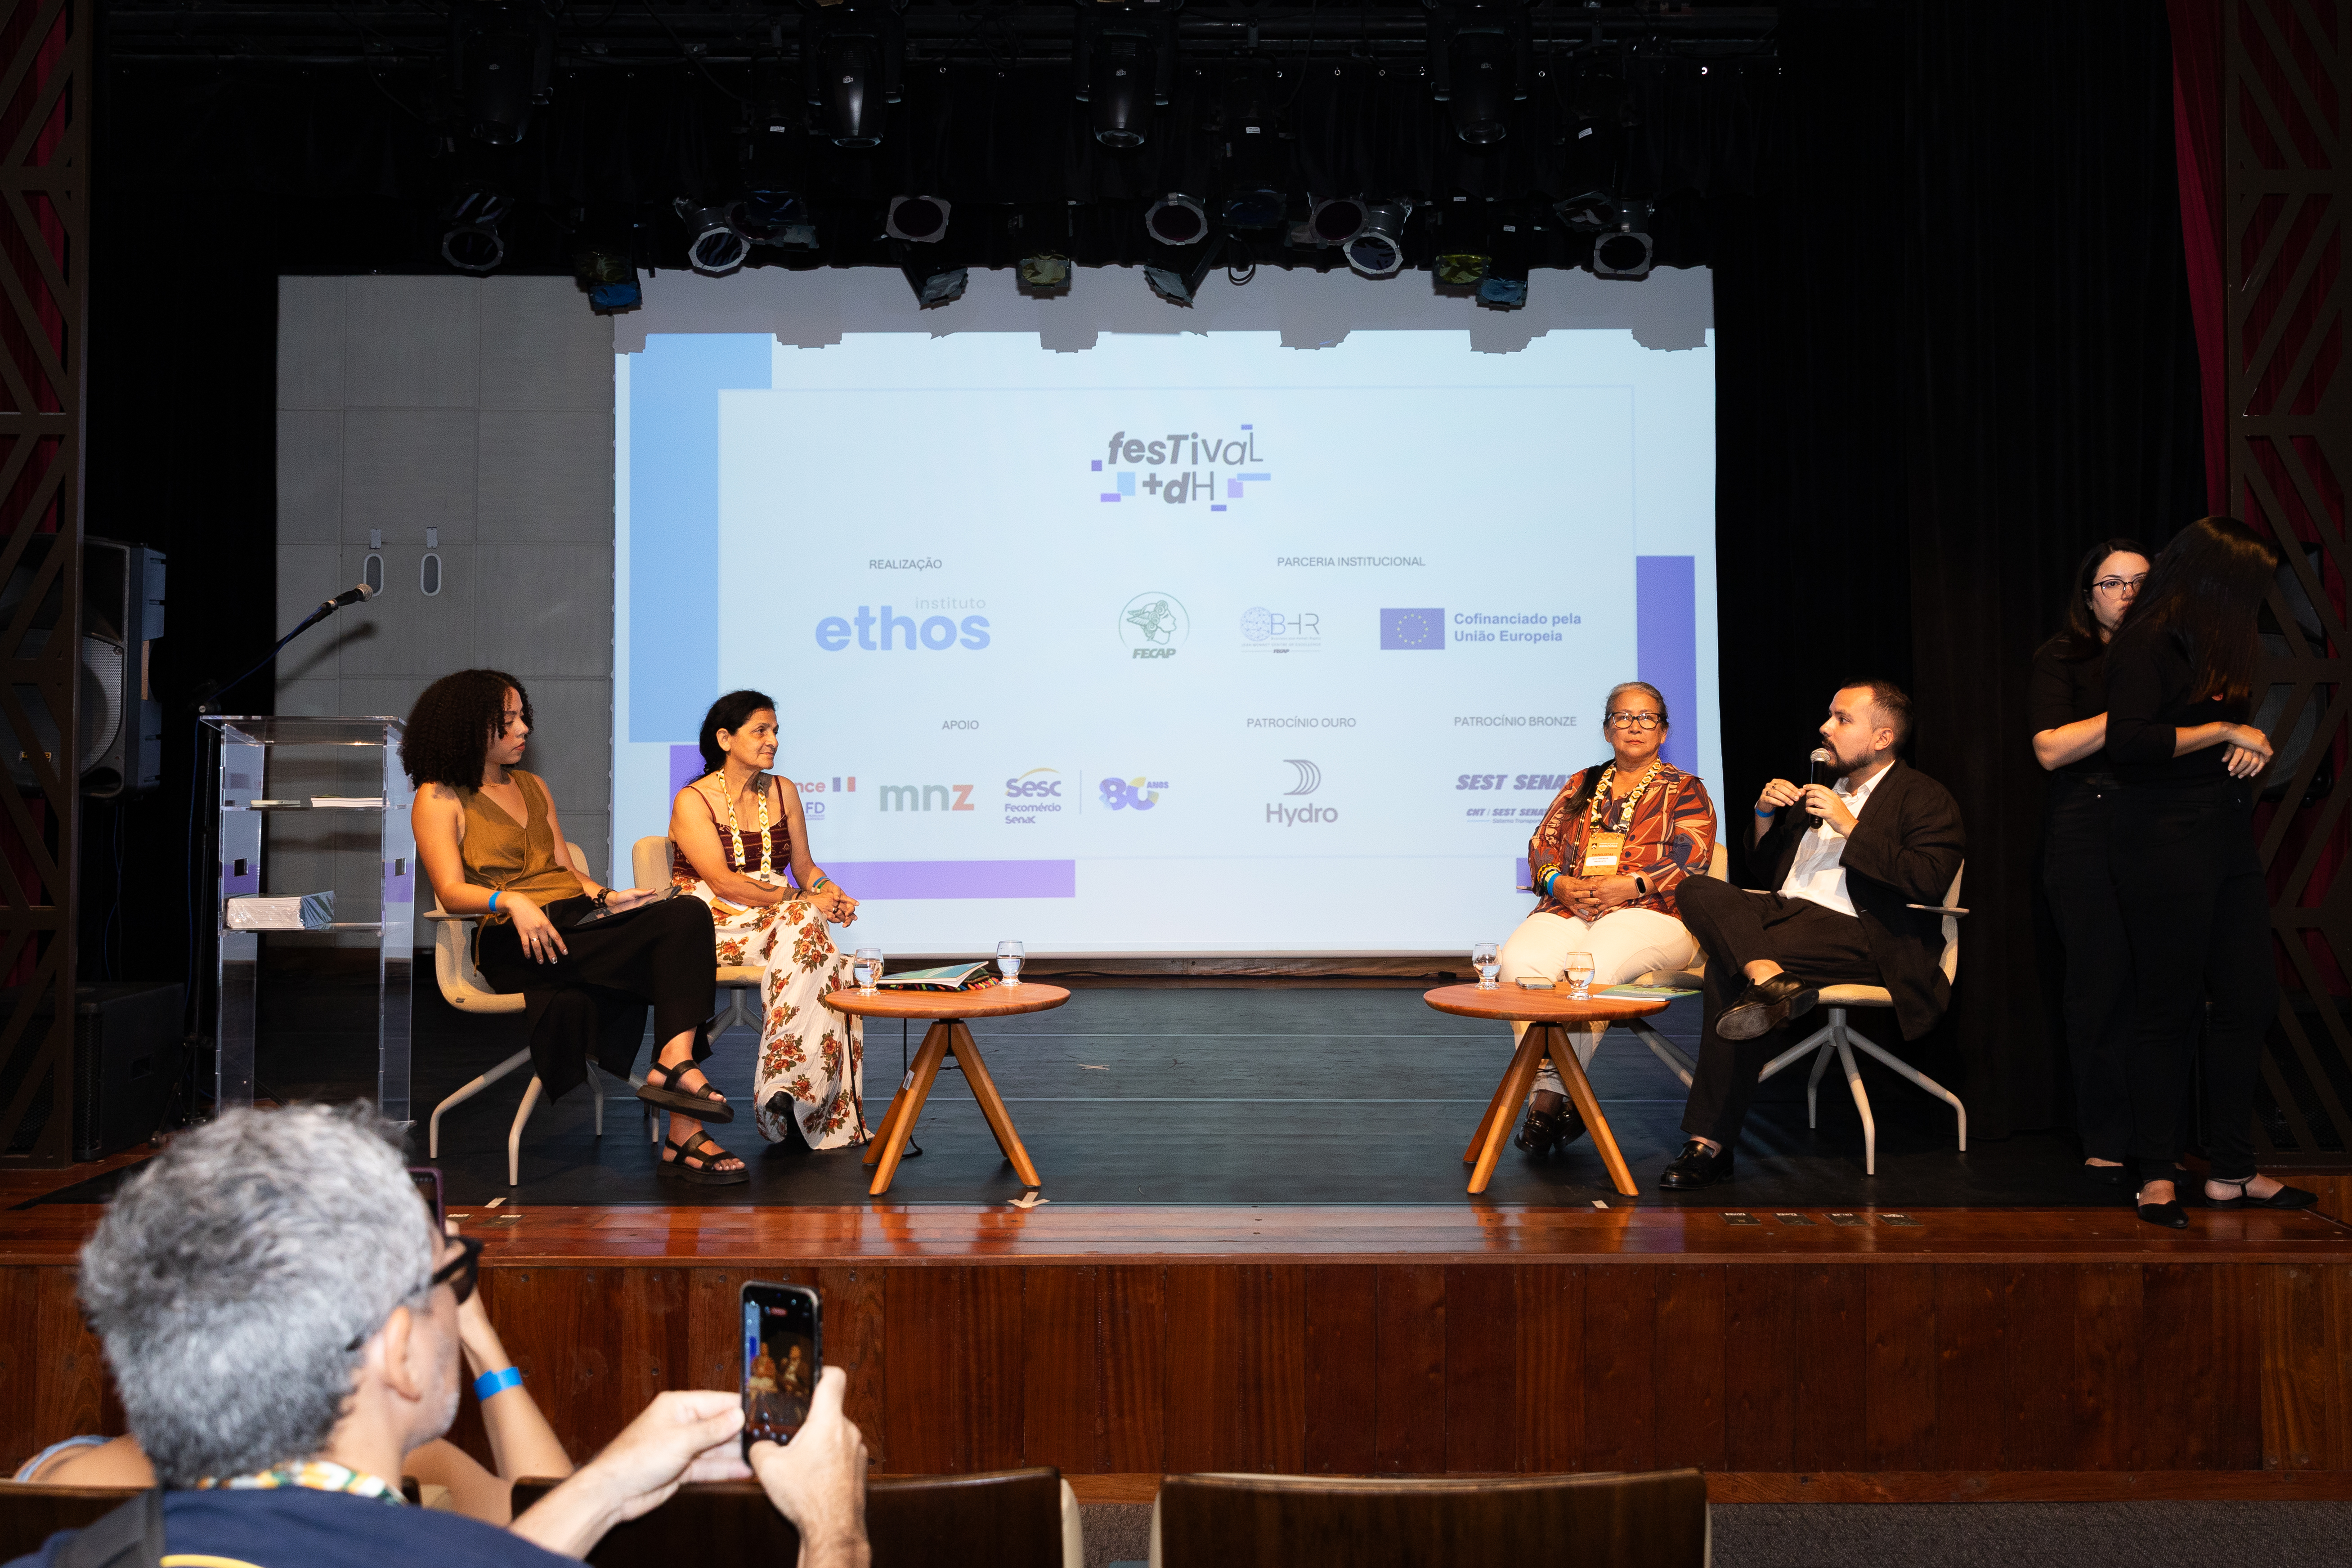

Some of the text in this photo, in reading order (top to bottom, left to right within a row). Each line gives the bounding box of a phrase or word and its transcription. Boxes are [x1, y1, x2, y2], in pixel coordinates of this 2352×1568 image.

[1142, 471, 1214, 504] +dH
[869, 557, 942, 572] REALIZAÇÃO
[1277, 556, 1426, 567] PARCERIA INSTITUCIONAL
[915, 596, 986, 610] instituto
[1454, 613, 1582, 627] Cofinanciado pela
[815, 605, 991, 652] ethos
[1454, 630, 1563, 644] União Europeia
[1132, 648, 1177, 659] FECAP
[942, 720, 980, 730] APOIO
[1246, 715, 1357, 728] PATROCÍNIO OURO
[1454, 714, 1577, 727] PATROCÍNIO BRONZE
[1005, 778, 1062, 797] Sesc
[1147, 781, 1169, 789] ANOS
[1455, 774, 1573, 790] SEST SENA
[880, 784, 975, 812] mnz
[1099, 776, 1159, 811] 80
[805, 802, 825, 814] FD
[1004, 802, 1062, 812] Fecomércio
[1466, 808, 1547, 816] CNT SEST SENA
[1005, 815, 1036, 824] Senac
[1266, 803, 1339, 827] Hydro
